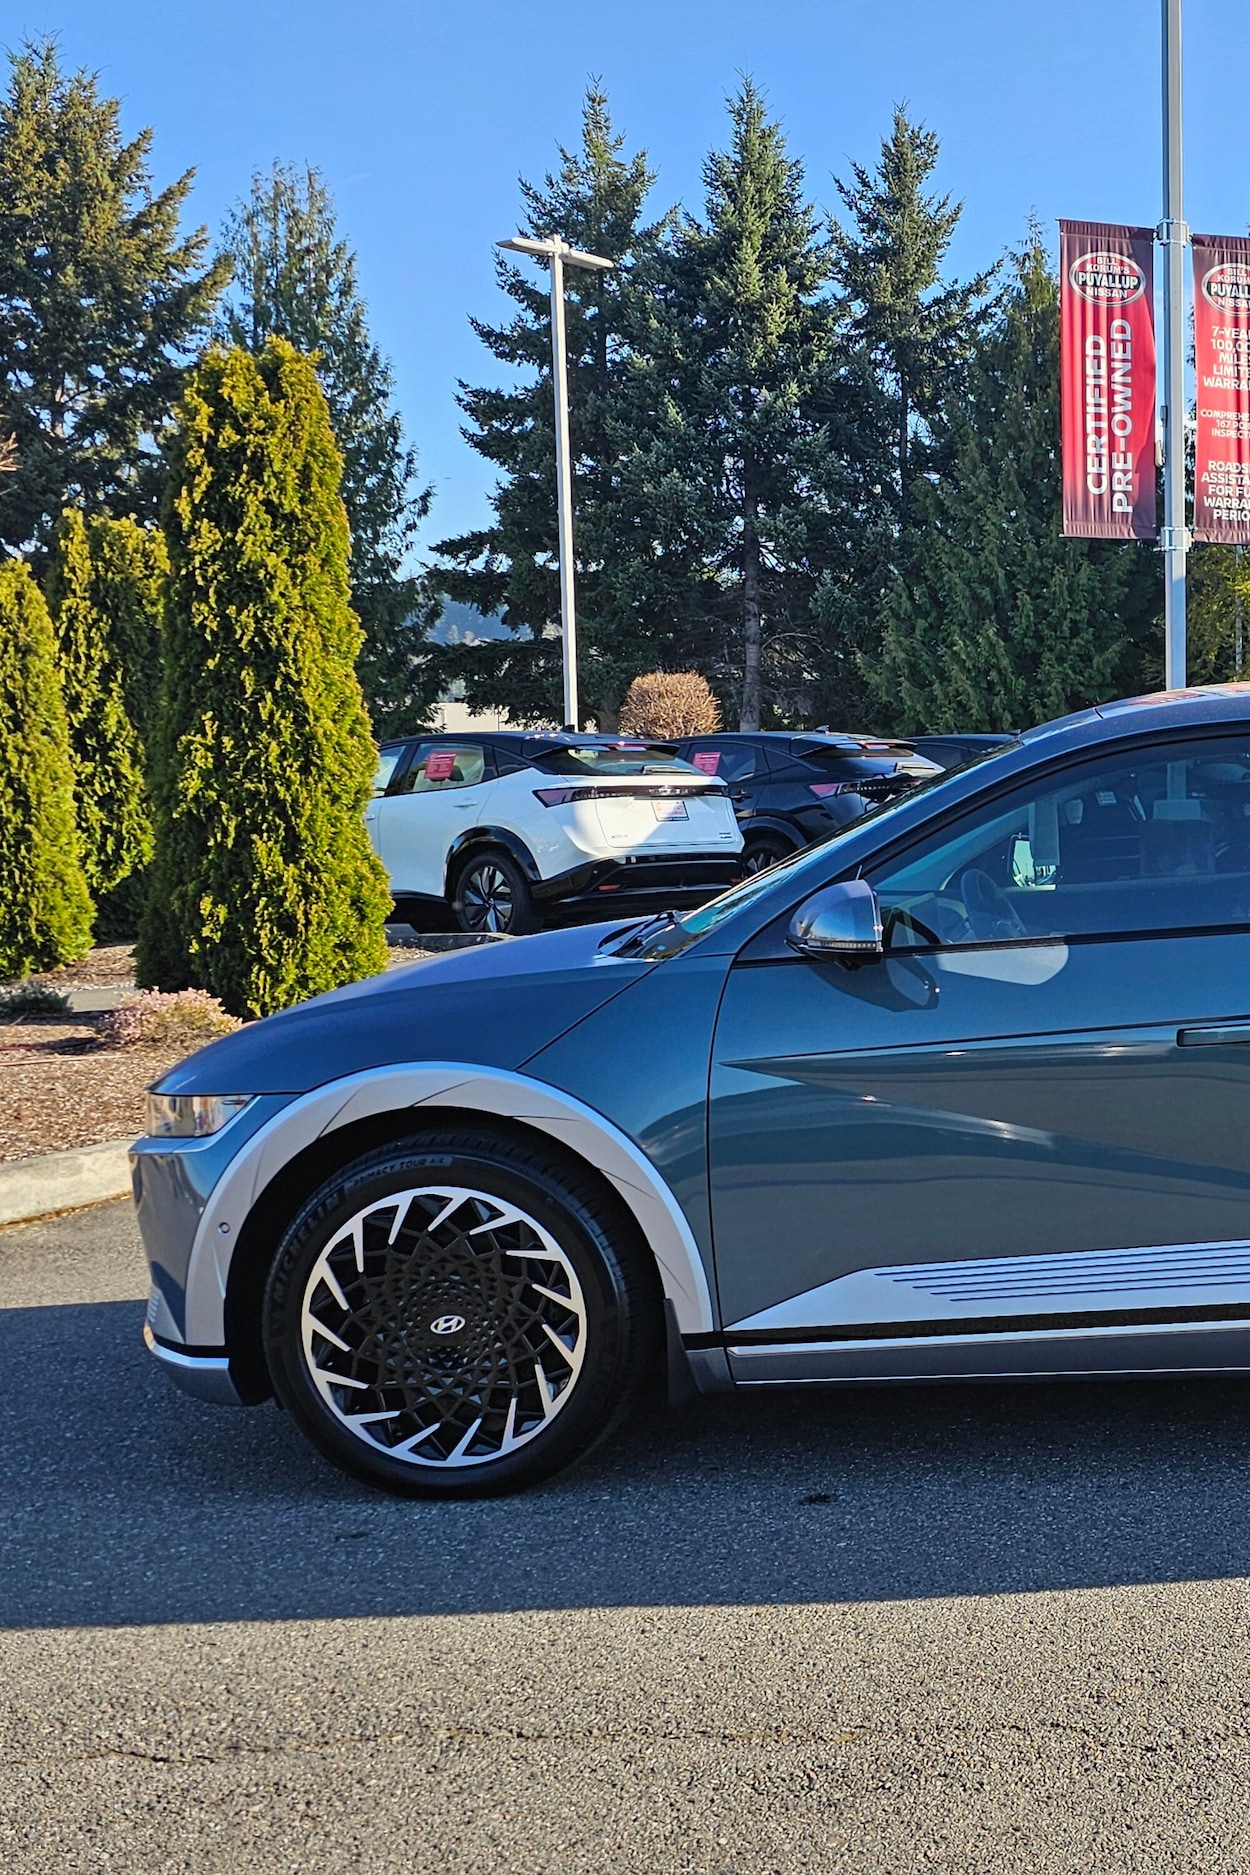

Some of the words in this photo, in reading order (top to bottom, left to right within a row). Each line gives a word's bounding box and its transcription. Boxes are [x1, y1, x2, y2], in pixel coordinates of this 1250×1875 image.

[1096, 257, 1117, 265] BILL
[1086, 263, 1130, 275] KORUM'S
[1227, 268, 1247, 277] BILL
[1078, 271, 1139, 289] PUYALLUP
[1086, 287, 1128, 298] NISSAN
[1085, 335, 1109, 495] CERTIFIED
[1111, 318, 1133, 513] PRE-OWNED
[1216, 419, 1231, 429] 167
[1208, 484, 1234, 496] FOR
[353, 1161, 396, 1186] PRIMACY
[399, 1158, 427, 1169] TOUR
[273, 1191, 341, 1304] MICHELIN
